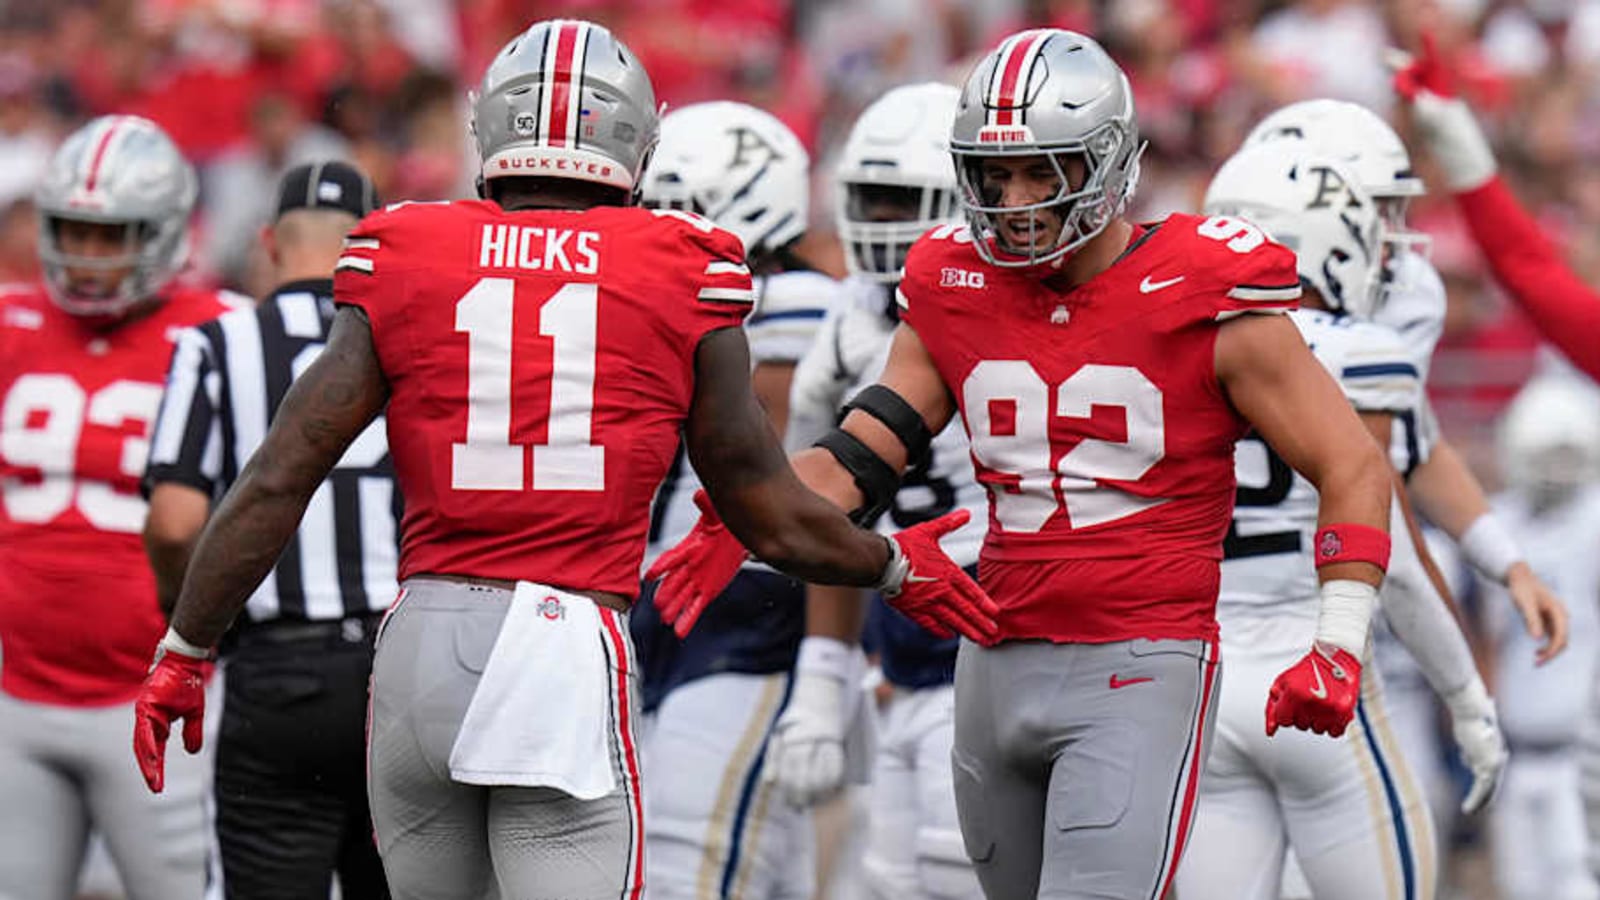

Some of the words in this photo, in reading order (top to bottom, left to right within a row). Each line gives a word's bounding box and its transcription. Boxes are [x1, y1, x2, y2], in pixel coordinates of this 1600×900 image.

[499, 157, 611, 176] BUCKEYES
[480, 224, 600, 275] HICKS
[0, 373, 163, 534] 93
[452, 277, 605, 492] 11
[962, 359, 1166, 533] 92
